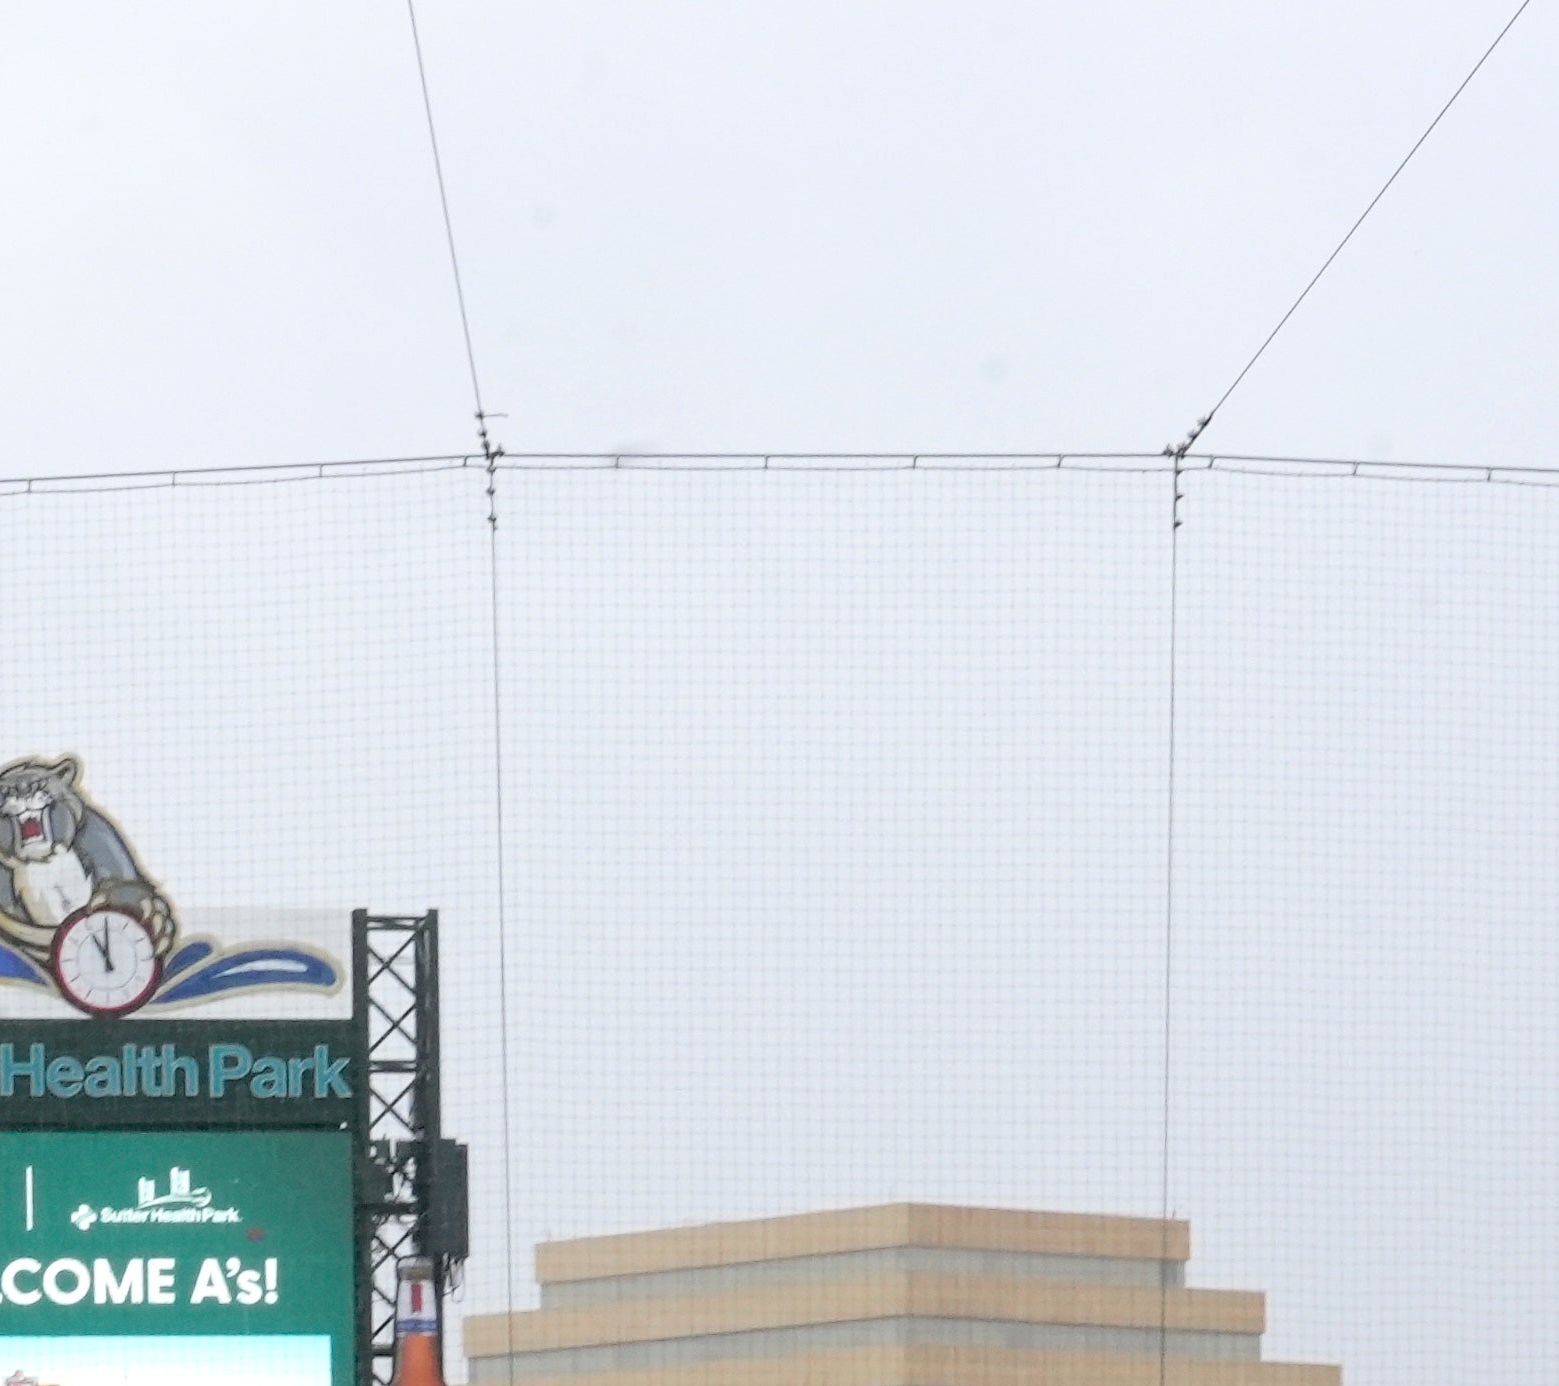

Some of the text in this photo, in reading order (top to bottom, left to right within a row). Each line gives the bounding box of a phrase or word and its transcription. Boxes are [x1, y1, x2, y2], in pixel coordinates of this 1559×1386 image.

[208, 1044, 352, 1098] Park
[100, 1207, 150, 1223] Sutter
[151, 1208, 201, 1223] Health
[190, 1257, 279, 1305] A's!
